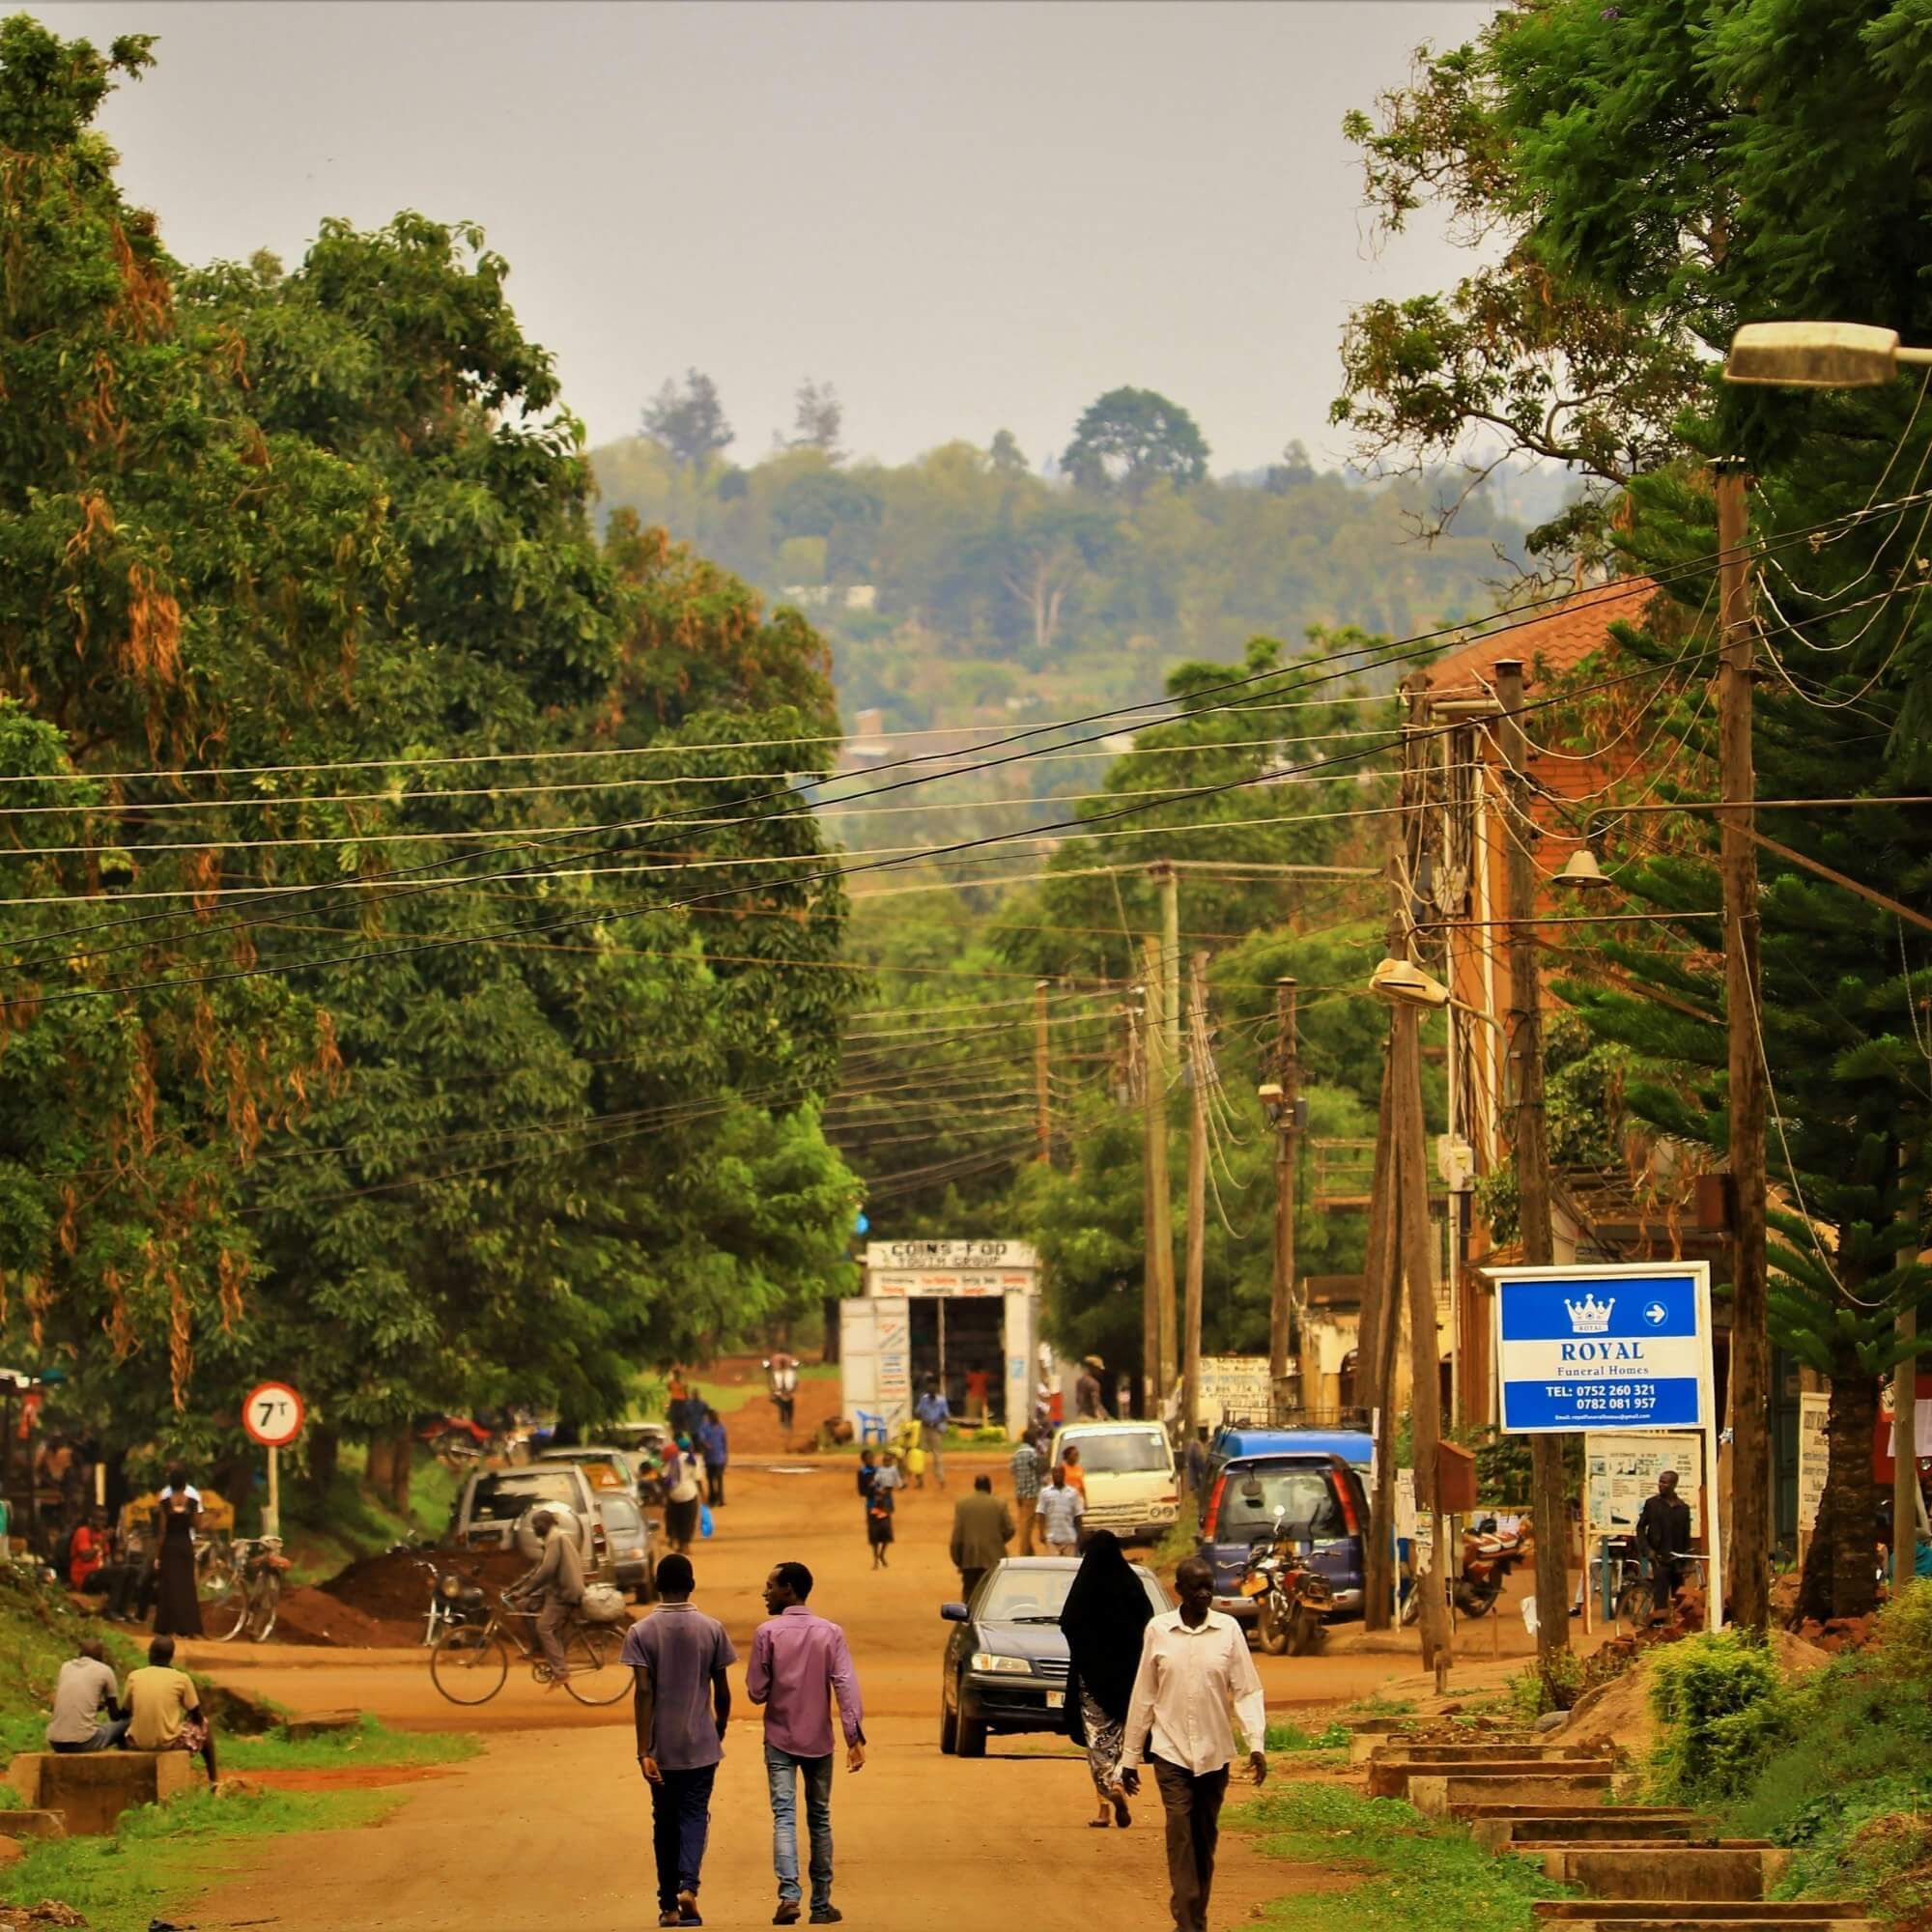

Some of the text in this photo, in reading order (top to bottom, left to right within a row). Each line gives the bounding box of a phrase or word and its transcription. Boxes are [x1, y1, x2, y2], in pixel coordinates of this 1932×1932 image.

[1561, 1342, 1644, 1361] ROYAL
[1557, 1365, 1649, 1377] Funeral Homes
[1546, 1384, 1655, 1397] TEL: 0752 260 321
[1577, 1398, 1656, 1409] 0782 081 957
